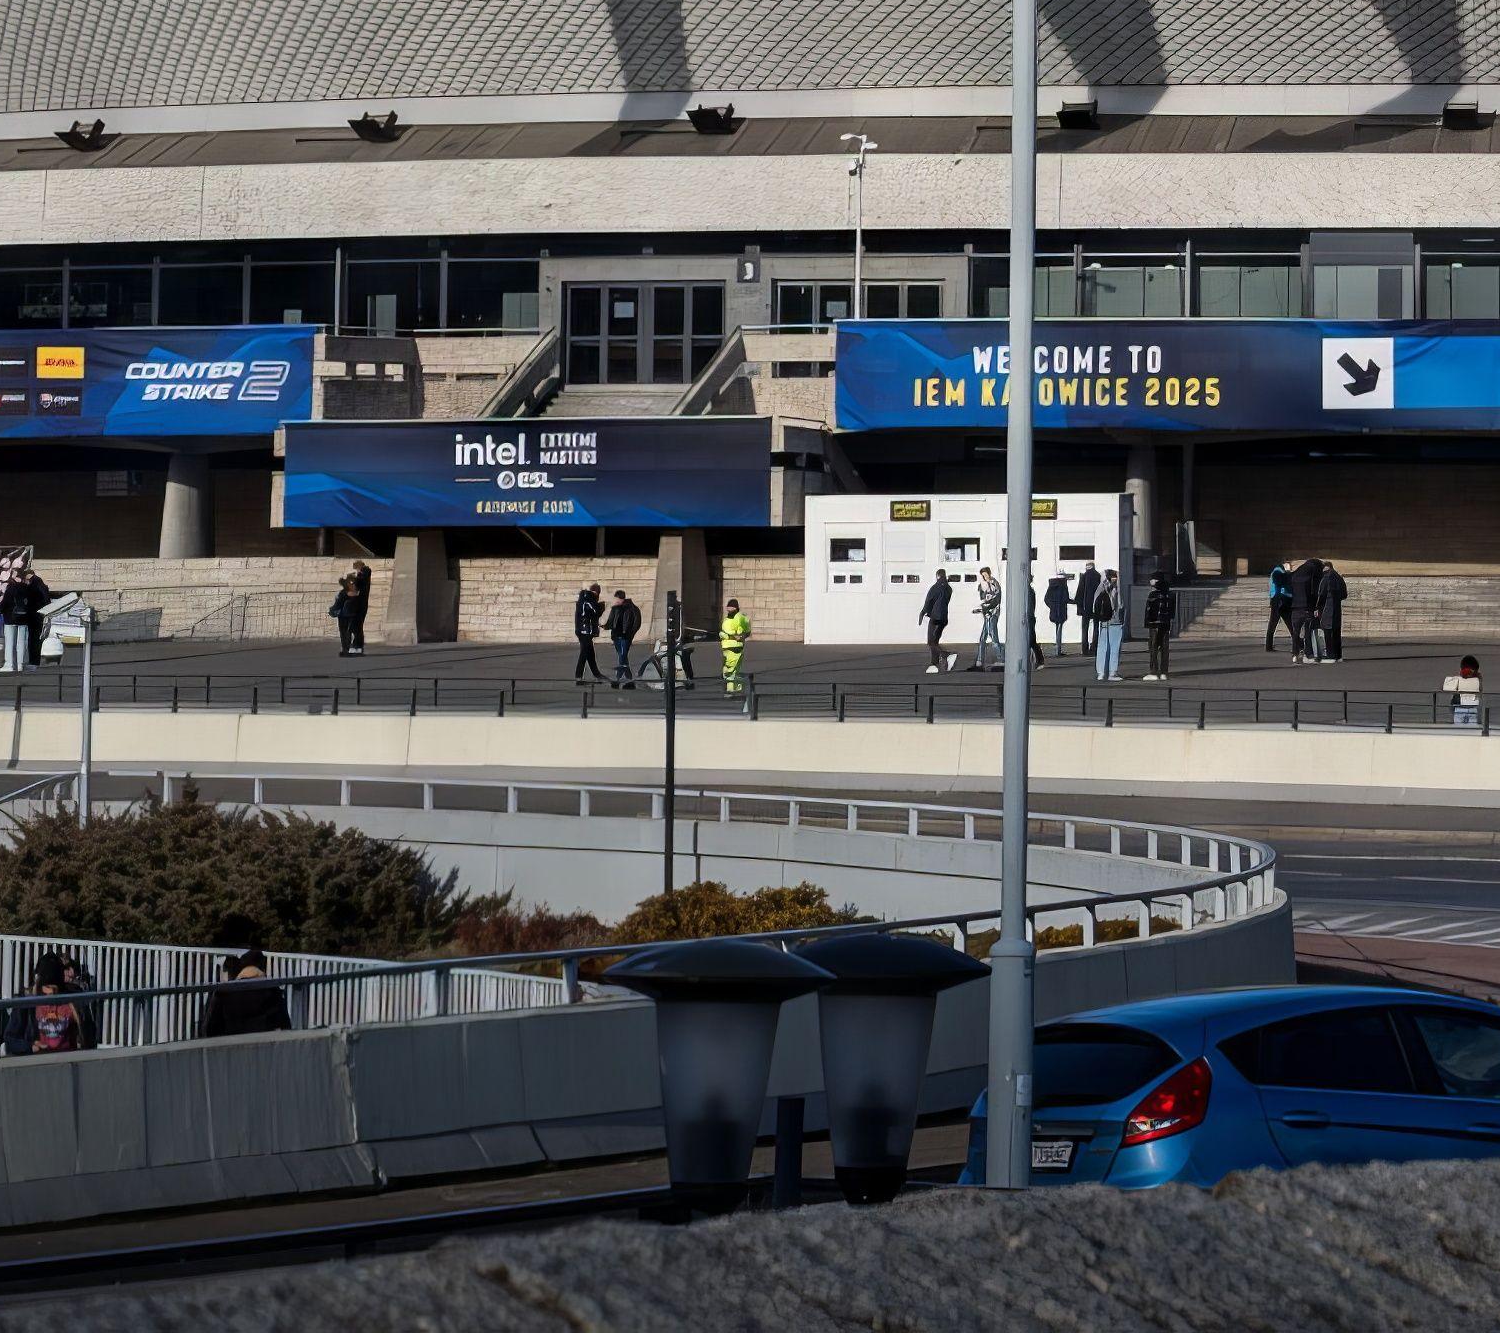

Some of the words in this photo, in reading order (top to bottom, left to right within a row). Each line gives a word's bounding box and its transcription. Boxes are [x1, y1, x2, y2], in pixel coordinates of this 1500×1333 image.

[125, 361, 245, 379] COUNTER
[972, 345, 1113, 374] WECOME
[1128, 345, 1163, 374] TO
[141, 383, 235, 400] STRIKE
[913, 378, 966, 407] IEM
[980, 377, 1130, 407] KAOWICE
[1144, 377, 1221, 407] 2025
